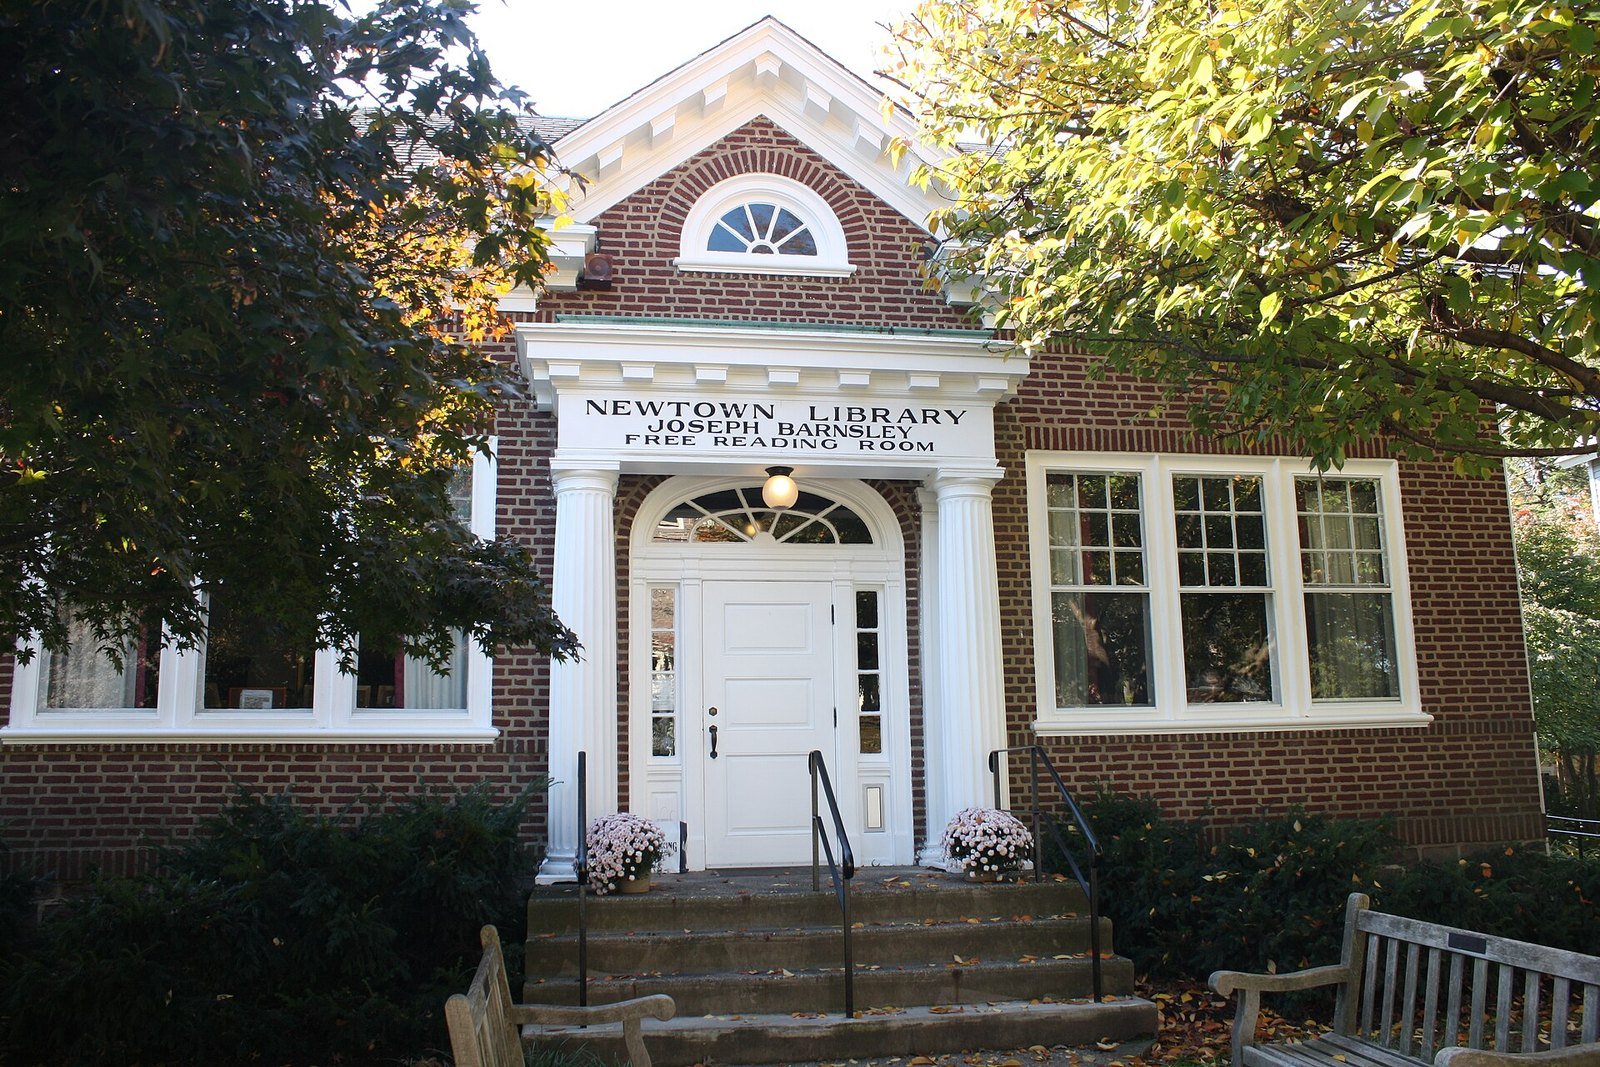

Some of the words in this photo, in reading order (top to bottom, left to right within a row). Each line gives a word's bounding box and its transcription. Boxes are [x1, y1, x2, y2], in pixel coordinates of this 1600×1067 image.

[586, 400, 775, 420] NEWTOWN
[809, 405, 967, 425] LIBRARY
[647, 419, 759, 435] JOSEPH
[777, 422, 913, 440] BARNSLEY
[625, 434, 696, 446] FREE
[713, 436, 838, 450] READING
[859, 440, 935, 452] ROOM
